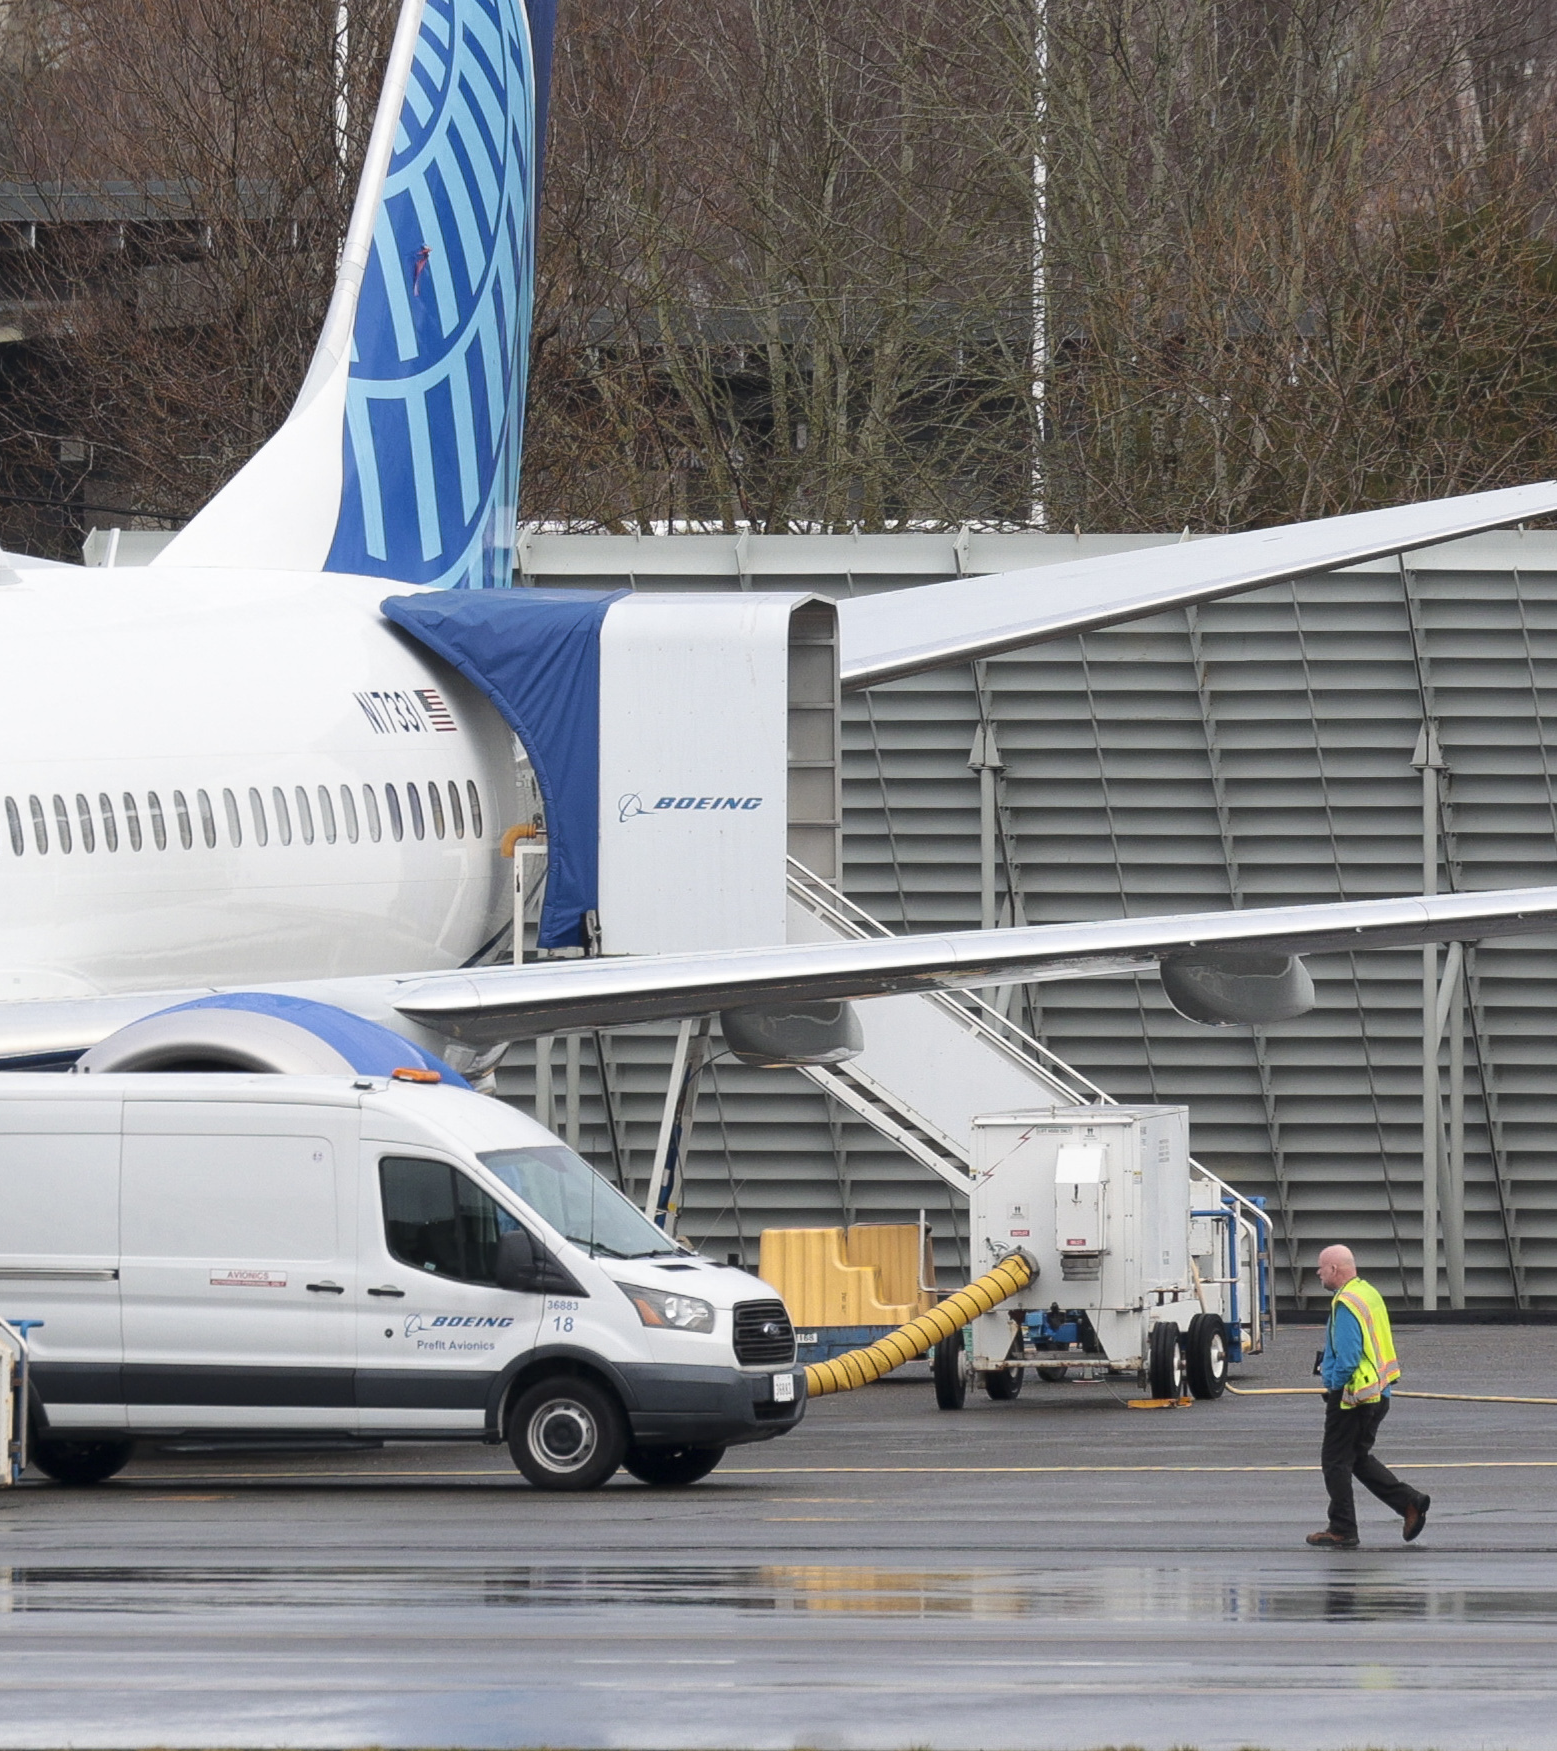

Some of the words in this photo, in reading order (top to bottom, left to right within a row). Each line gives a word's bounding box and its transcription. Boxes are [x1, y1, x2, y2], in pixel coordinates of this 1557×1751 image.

[352, 691, 428, 734] N17331
[653, 797, 763, 810] BOEING
[227, 1271, 270, 1280] AVIONICS
[547, 1301, 579, 1311] 36883
[431, 1316, 515, 1328] BOEING
[553, 1317, 574, 1333] 18
[448, 1341, 495, 1350] Avionics
